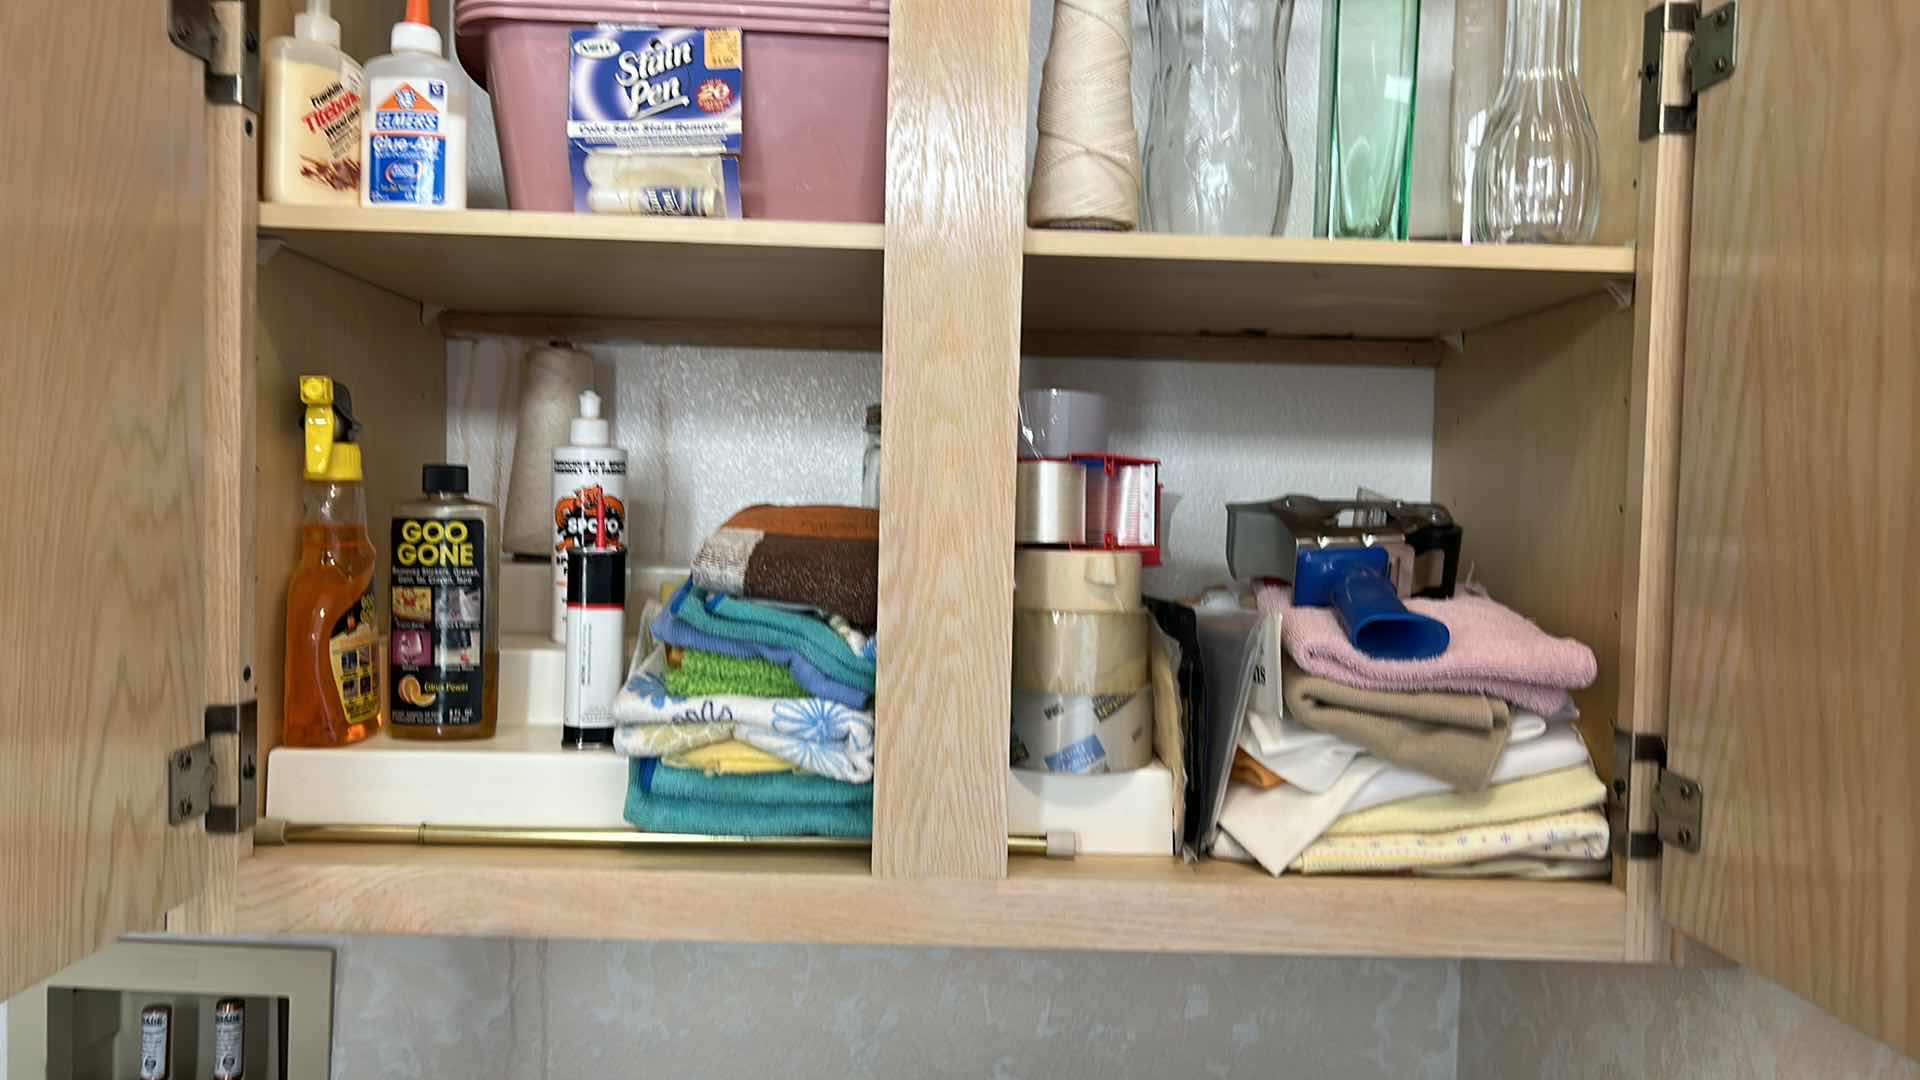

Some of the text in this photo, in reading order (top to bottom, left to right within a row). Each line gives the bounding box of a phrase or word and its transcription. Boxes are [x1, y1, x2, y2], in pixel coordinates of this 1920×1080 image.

[615, 38, 694, 88] Stain
[624, 76, 687, 120] Pen
[698, 83, 731, 98] 20
[402, 520, 468, 544] GOO
[397, 543, 474, 567] GONE
[446, 682, 469, 693] Power
